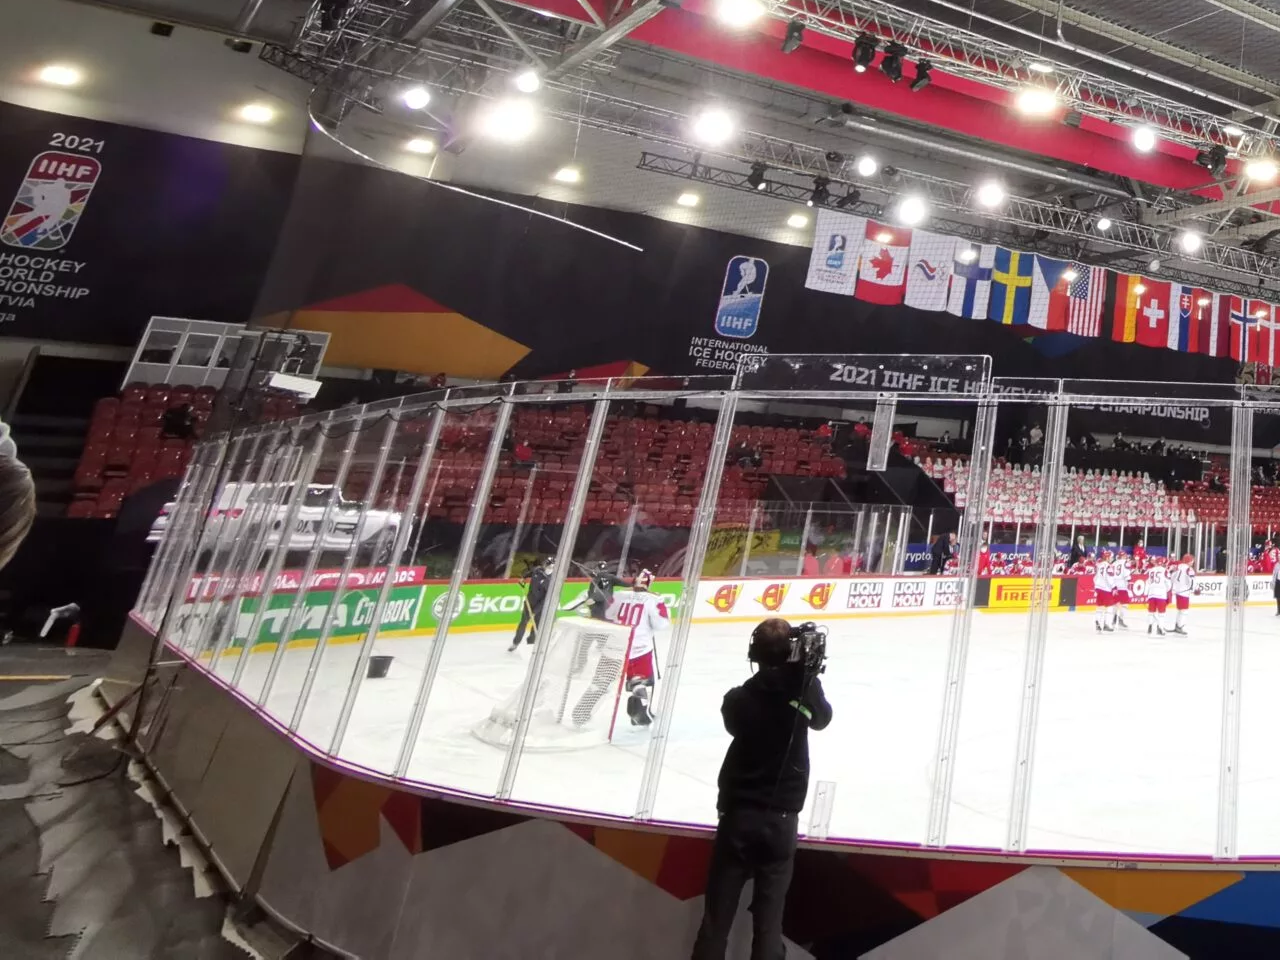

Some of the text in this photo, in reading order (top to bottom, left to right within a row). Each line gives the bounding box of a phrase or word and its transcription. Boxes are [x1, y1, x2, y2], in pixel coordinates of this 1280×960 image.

[48, 132, 105, 154] 2021
[38, 159, 93, 179] IIHF
[0, 252, 87, 274] HOCKEY
[720, 315, 753, 330] IIHF
[691, 336, 769, 354] INTERNATIONAL
[688, 345, 769, 367] ICE HOCKEY
[829, 363, 877, 386] 2021
[881, 370, 925, 391] IIHF
[928, 376, 960, 393] ICE
[905, 551, 933, 562] rypto.
[850, 583, 883, 595] LIQUI
[895, 582, 926, 594] LIQUI
[1199, 581, 1222, 591] SSOT
[847, 596, 881, 608] MOLY
[893, 595, 923, 607] MOLY
[617, 602, 645, 627] 40
